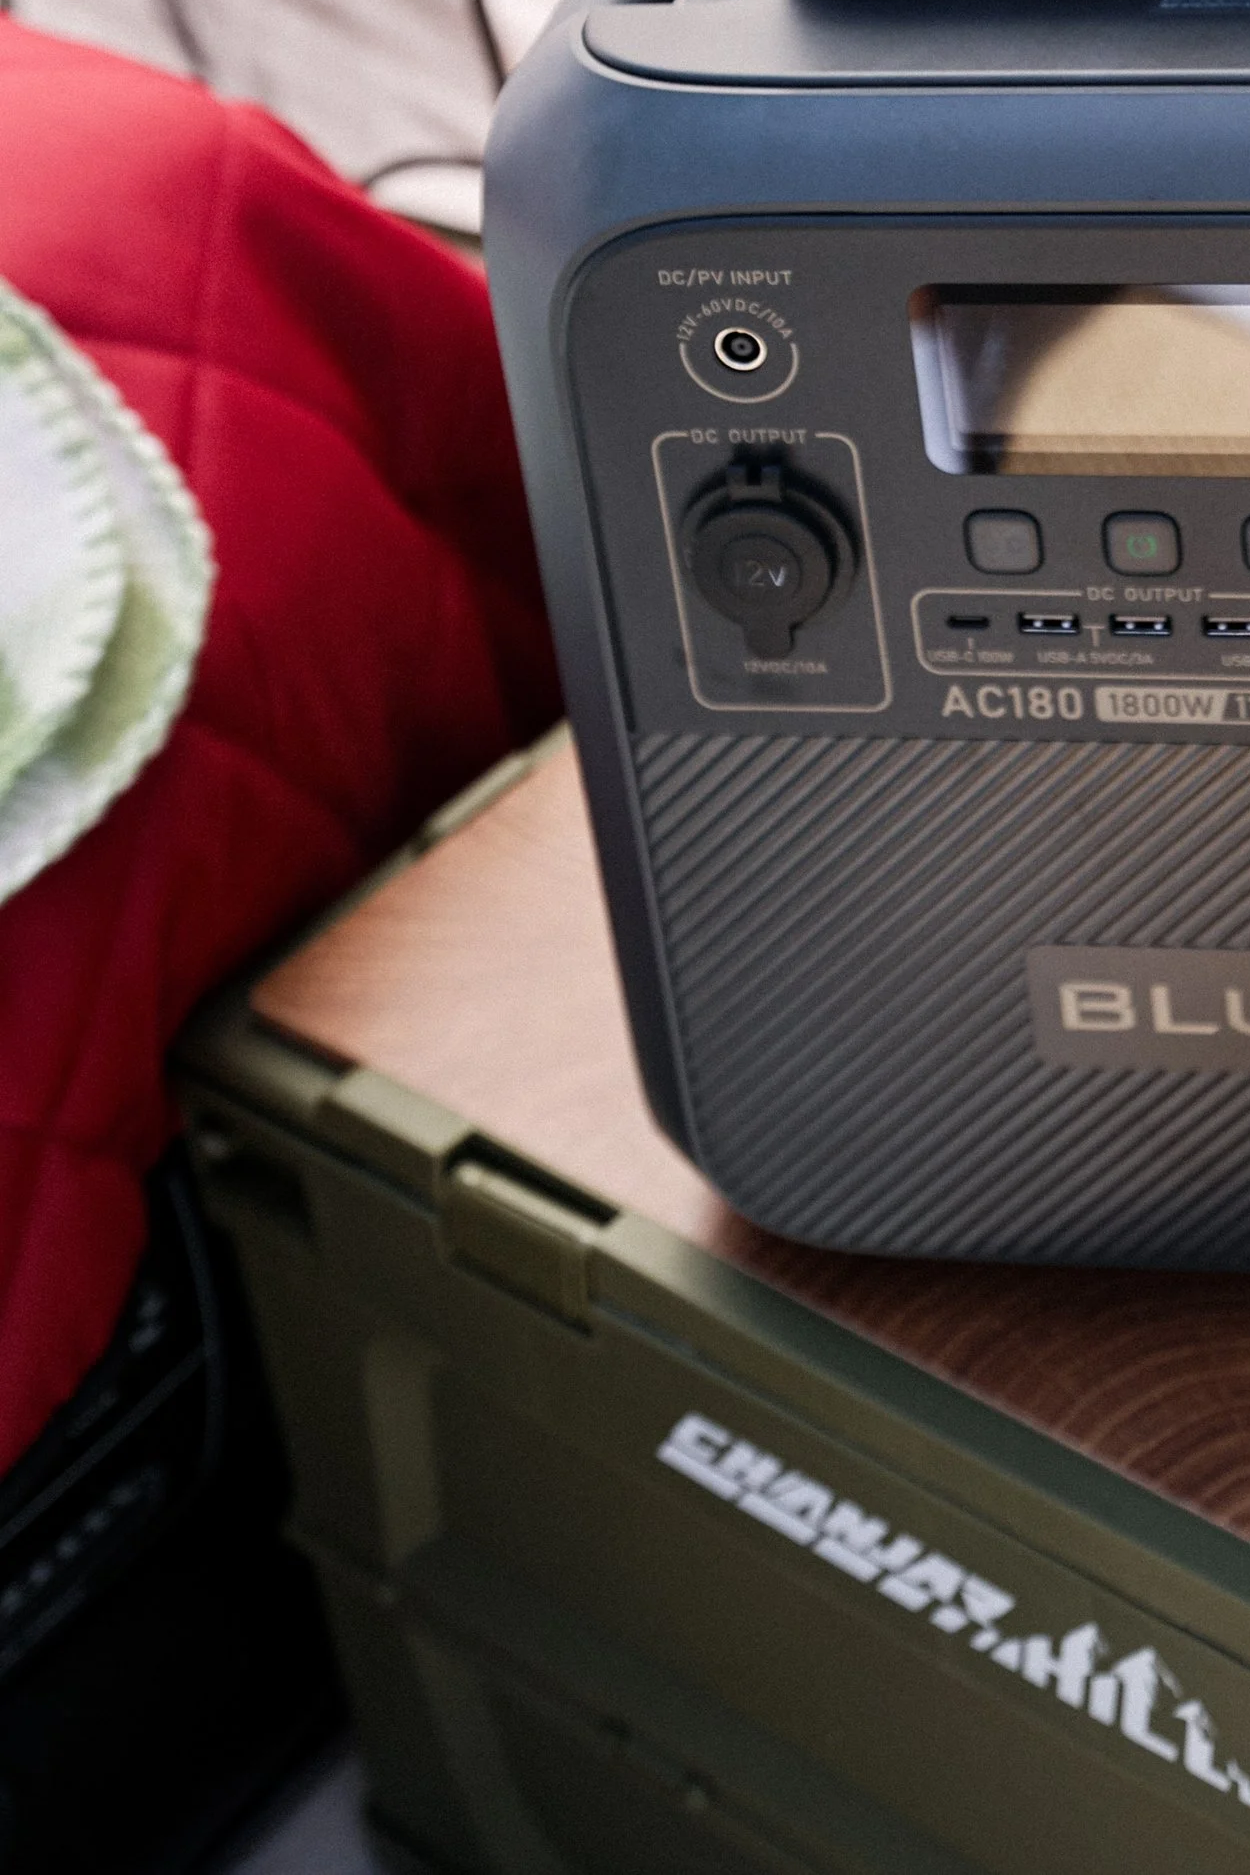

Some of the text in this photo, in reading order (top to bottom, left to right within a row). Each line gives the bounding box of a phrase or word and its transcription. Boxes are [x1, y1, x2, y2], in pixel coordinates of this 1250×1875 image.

[658, 268, 793, 288] DC/PV INPUT
[691, 429, 808, 445] DC OUTPUT
[1086, 586, 1203, 602] DC OUTPUT
[942, 684, 1084, 720] AC180
[1107, 692, 1214, 718] 1800W
